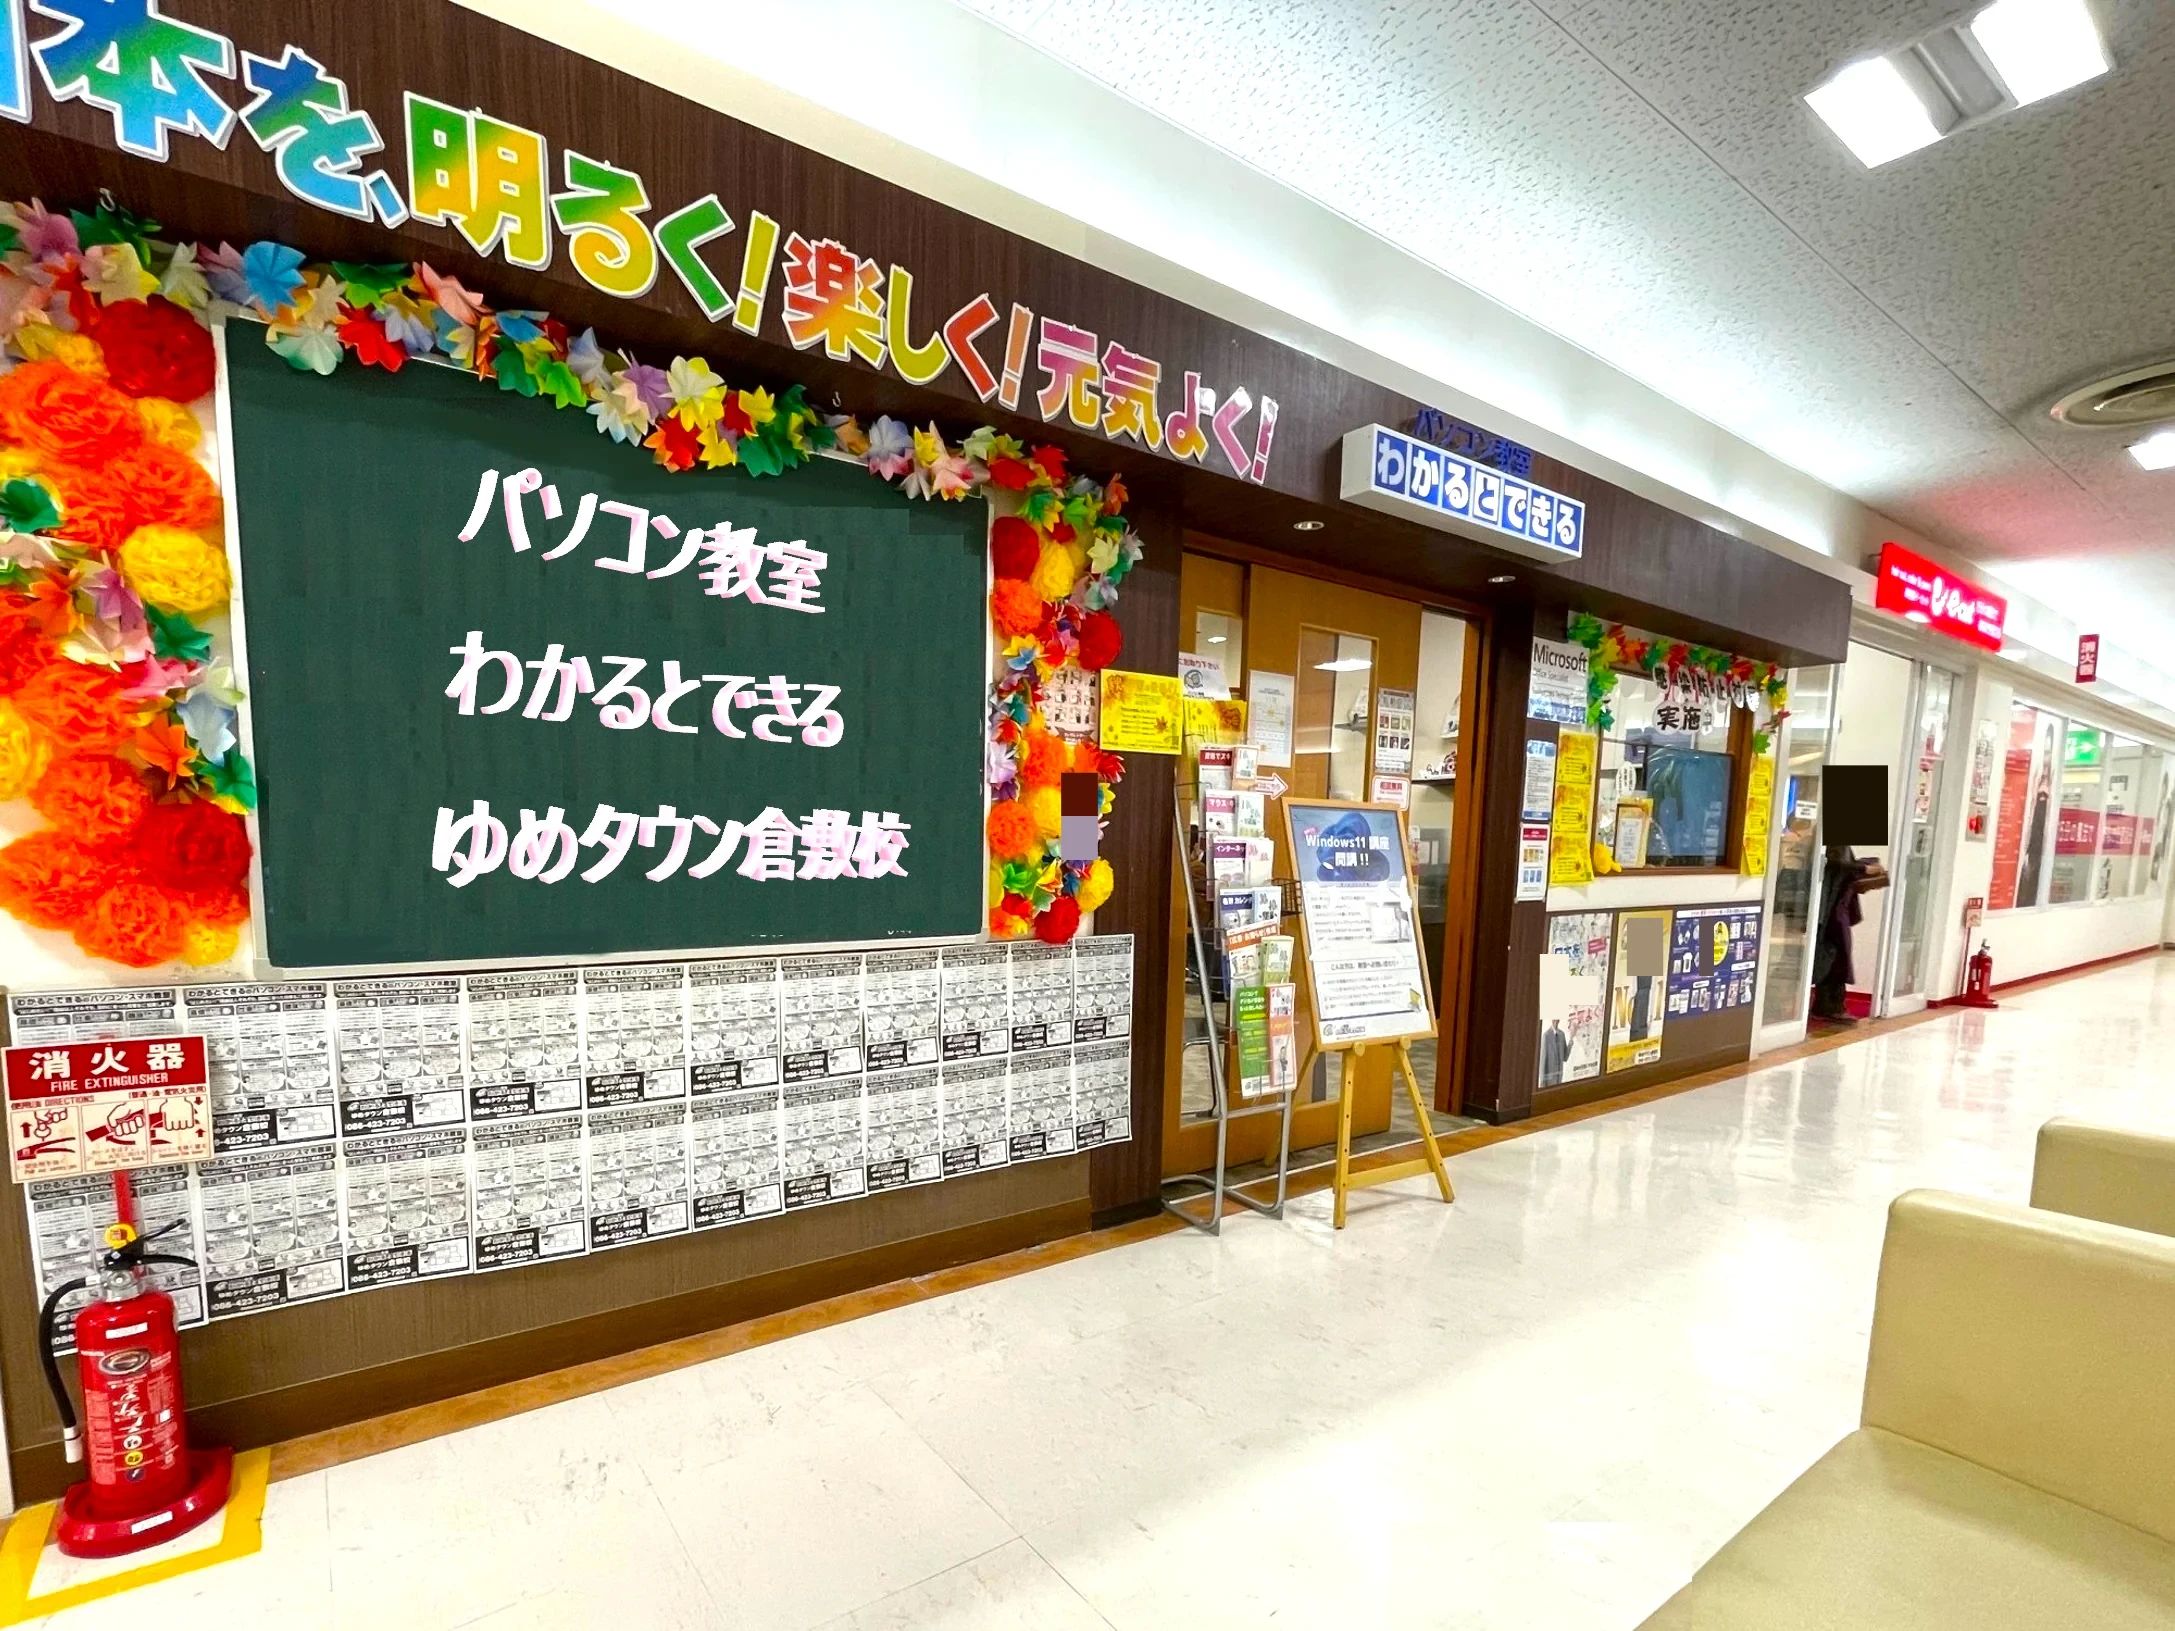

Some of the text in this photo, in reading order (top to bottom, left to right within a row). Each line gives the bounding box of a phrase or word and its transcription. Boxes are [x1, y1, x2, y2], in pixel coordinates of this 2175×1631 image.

[1377, 437, 1577, 546] わかるとできる
[458, 468, 828, 613] パソコン教室
[1533, 643, 1587, 672] Microsoft
[445, 631, 845, 747] わかるとできる
[432, 800, 911, 889] ゆめタウン倉敷校
[1305, 835, 1366, 849] Windows11
[29, 1043, 186, 1080] 消火器
[51, 1072, 169, 1092] FIRE EXTINGUISHER
[44, 1095, 95, 1107] DIRECTIONS
